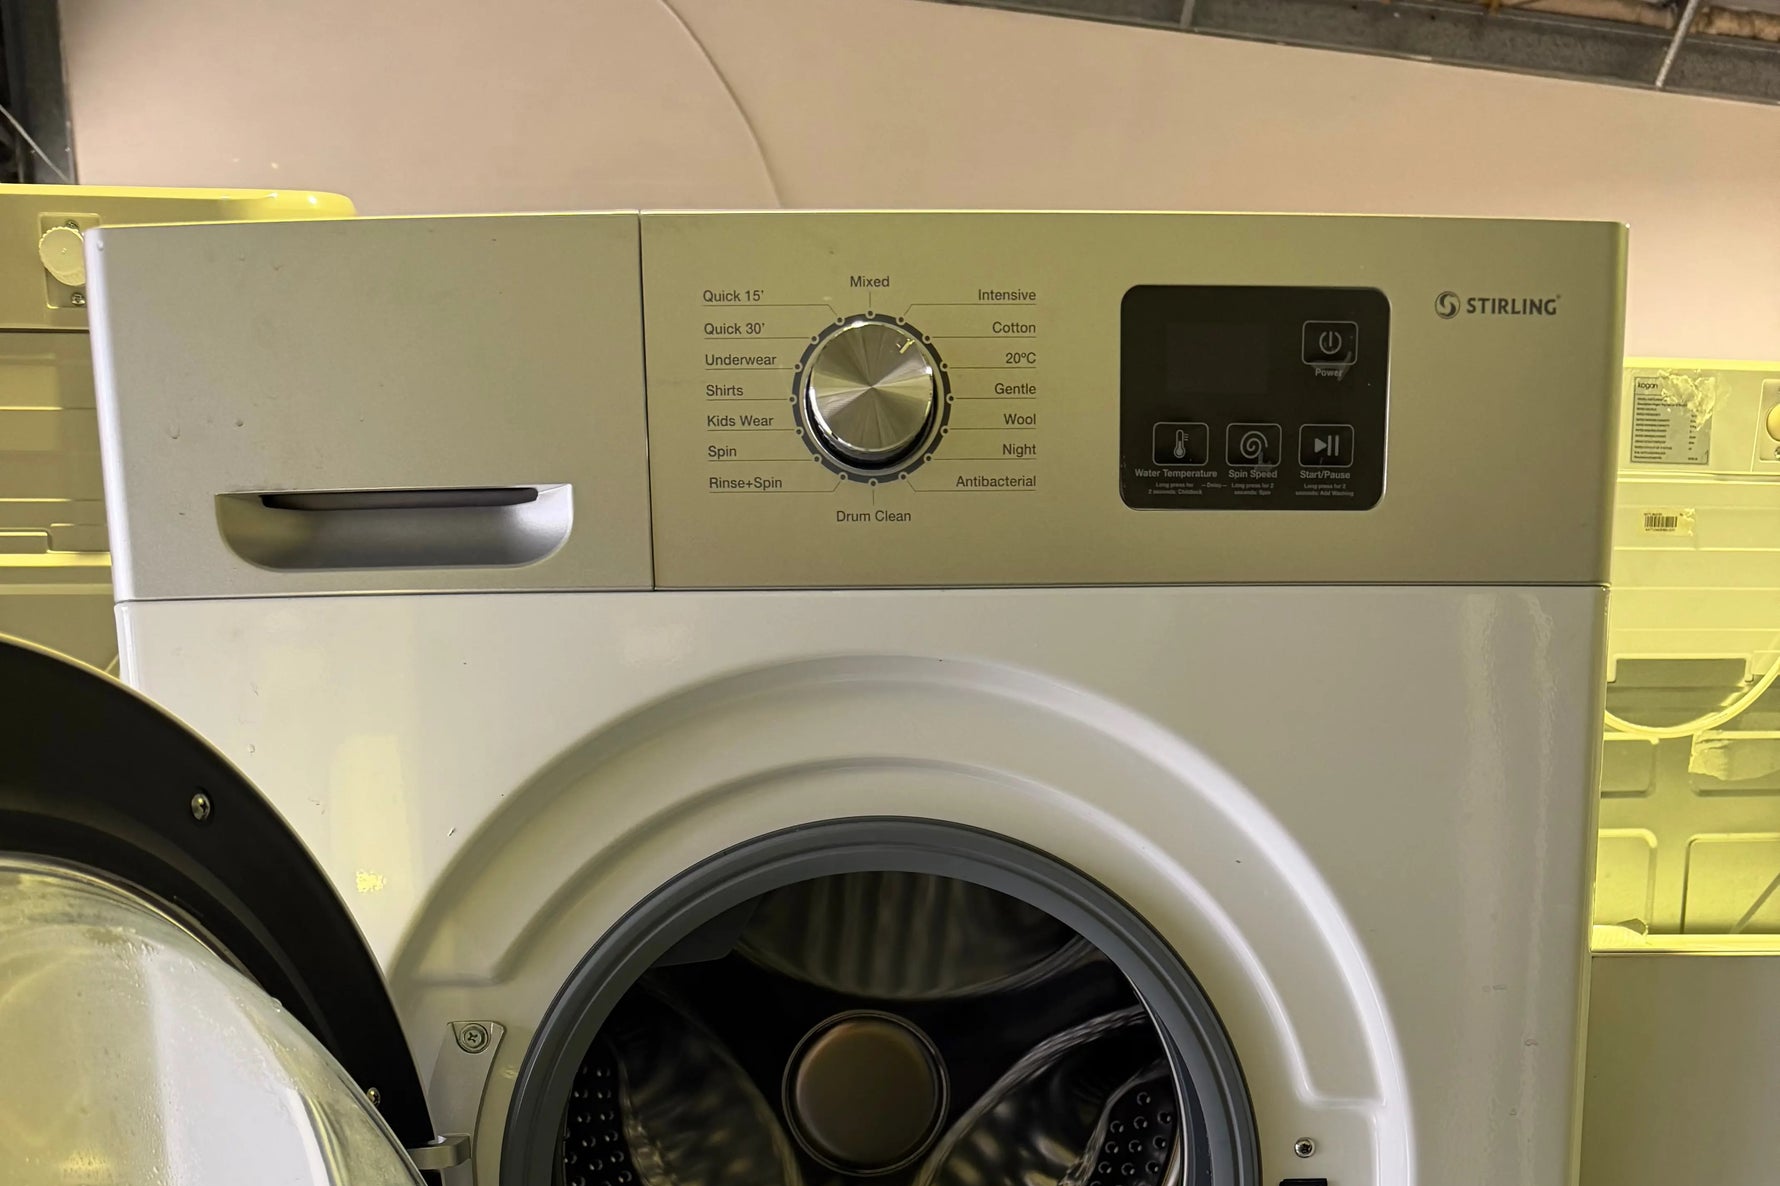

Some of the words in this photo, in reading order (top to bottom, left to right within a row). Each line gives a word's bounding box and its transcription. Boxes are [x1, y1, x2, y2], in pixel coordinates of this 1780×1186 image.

[849, 276, 890, 288] Mixed
[703, 290, 741, 303] Quick
[978, 289, 1036, 301] Intensive
[1466, 297, 1557, 315] STIRLING
[704, 323, 742, 336] Quick
[992, 322, 1036, 334] Cotton
[705, 354, 777, 366] Underwear
[1315, 368, 1343, 378] Power
[706, 384, 744, 397] Shirts
[994, 383, 1037, 395] Gentle
[707, 415, 737, 428] Kids
[739, 415, 774, 427] Wear
[1004, 413, 1036, 426] Wool
[708, 445, 737, 458] Spin
[1002, 443, 1036, 457] Night
[1134, 469, 1161, 478] Water
[1163, 469, 1217, 479] Temperature
[1228, 470, 1249, 479] Spin
[1250, 469, 1278, 479] Speed
[1300, 470, 1351, 480] Start/Pause
[709, 477, 783, 490] Rinse+Spin
[956, 476, 1036, 488] Antibacterial
[836, 510, 871, 522] Drum
[875, 510, 911, 522] Clean
